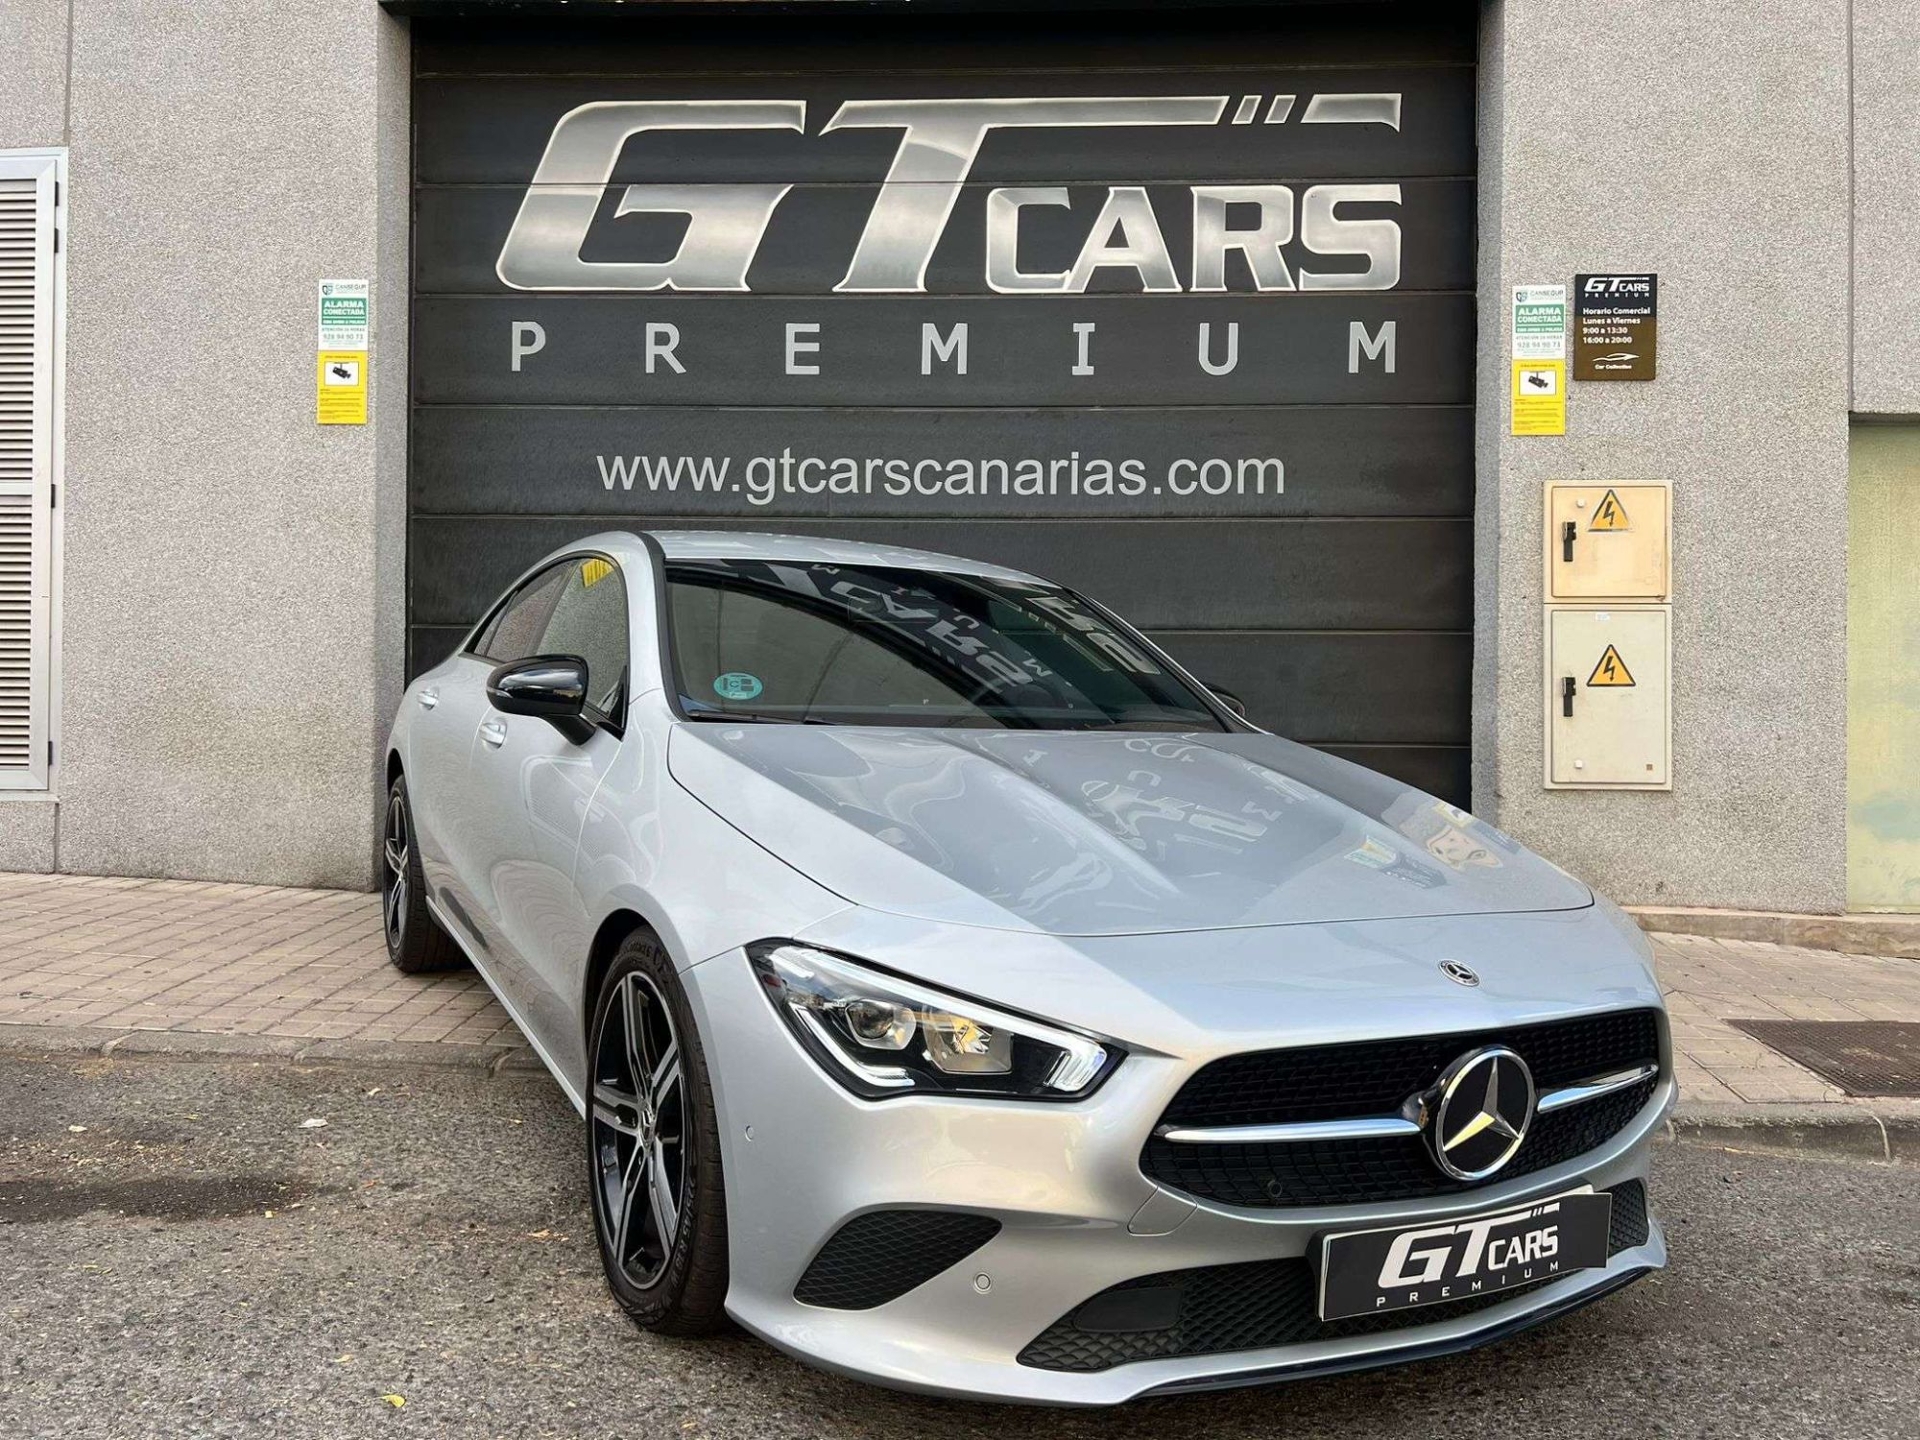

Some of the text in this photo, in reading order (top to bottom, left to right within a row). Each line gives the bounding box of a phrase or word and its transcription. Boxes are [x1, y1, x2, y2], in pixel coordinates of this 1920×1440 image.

[324, 300, 364, 308] ALARMA
[1518, 307, 1561, 315] ALARMA
[1582, 307, 1650, 315] Horario Comercial
[1517, 315, 1562, 323] CONECTADA
[510, 321, 1397, 376] PREMIUM
[596, 449, 1286, 505] www.gtcarscanarias.com
[1376, 1261, 1559, 1307] PREMIUM
